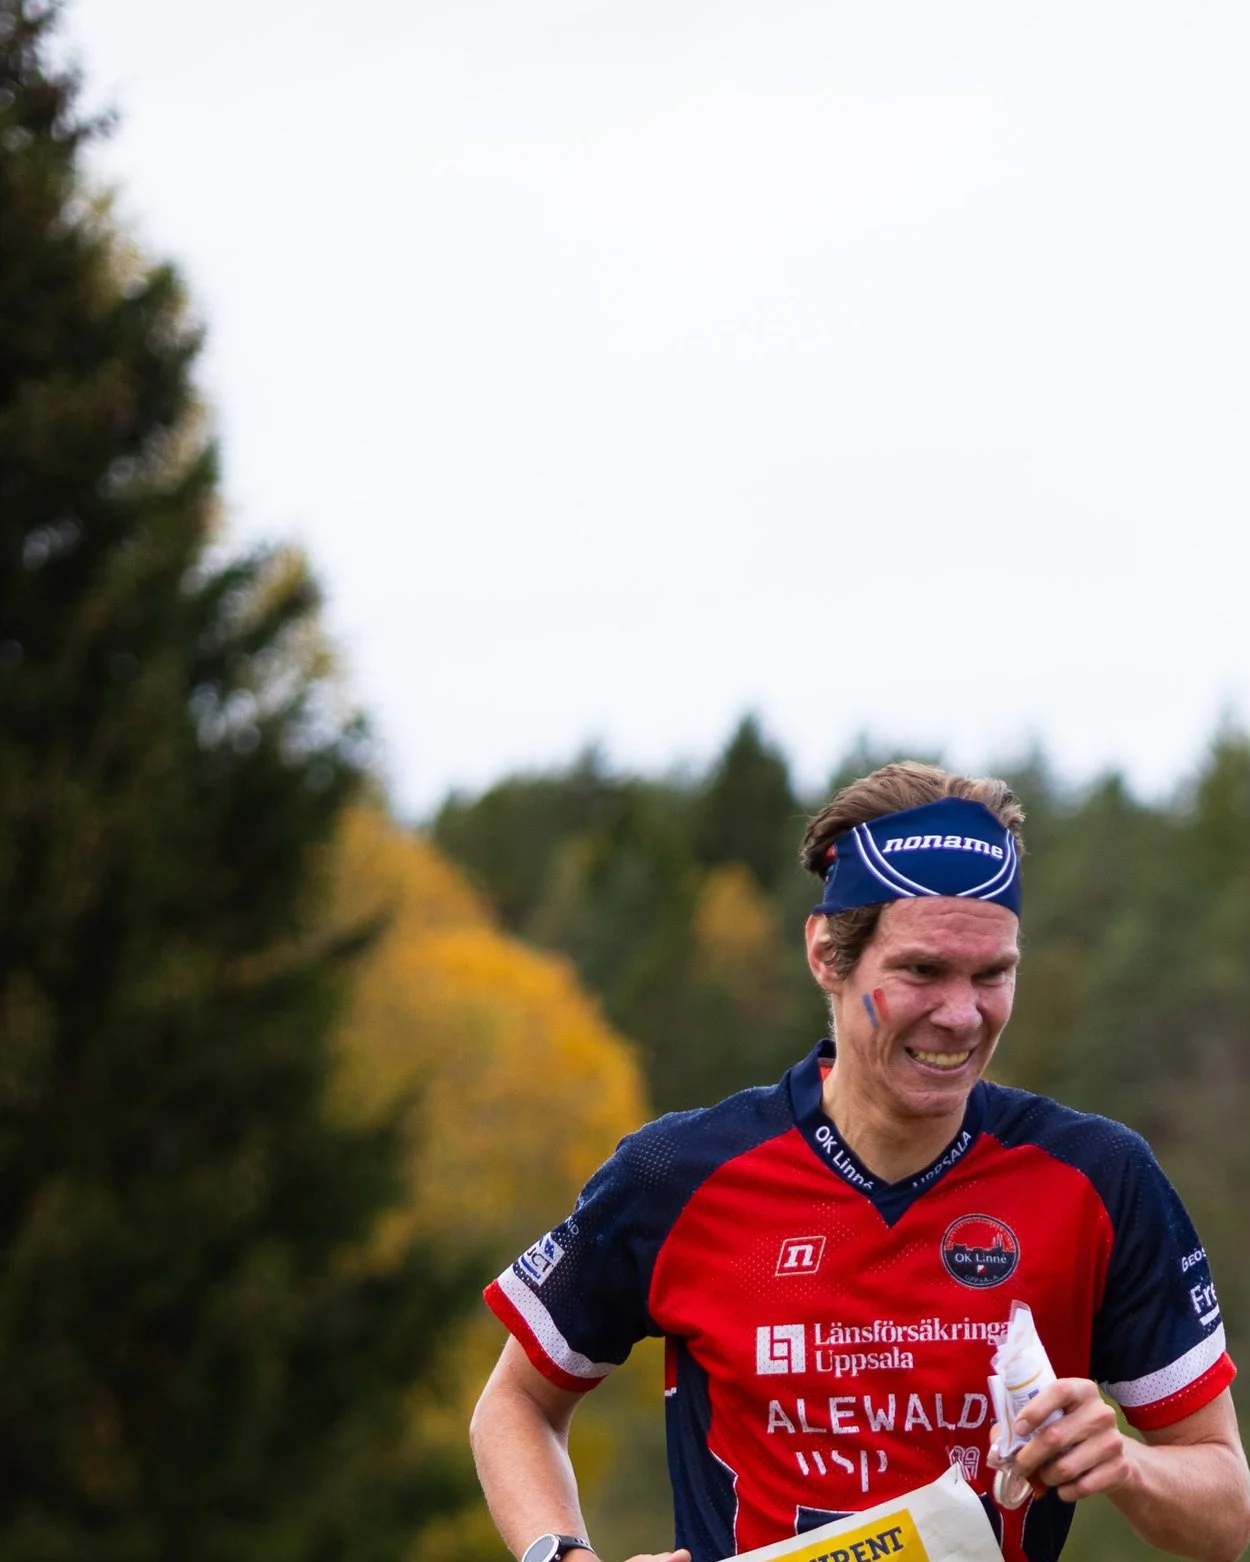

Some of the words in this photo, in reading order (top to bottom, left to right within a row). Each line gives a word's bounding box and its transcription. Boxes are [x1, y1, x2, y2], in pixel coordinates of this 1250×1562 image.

[881, 834, 1004, 860] noname
[815, 1125, 838, 1154] OK
[954, 1252, 972, 1263] OK
[976, 1251, 1008, 1264] Linné
[814, 1317, 1012, 1346] Länsförsäkringa
[815, 1346, 914, 1377] Uppsala
[767, 1392, 997, 1435] ALEWALD
